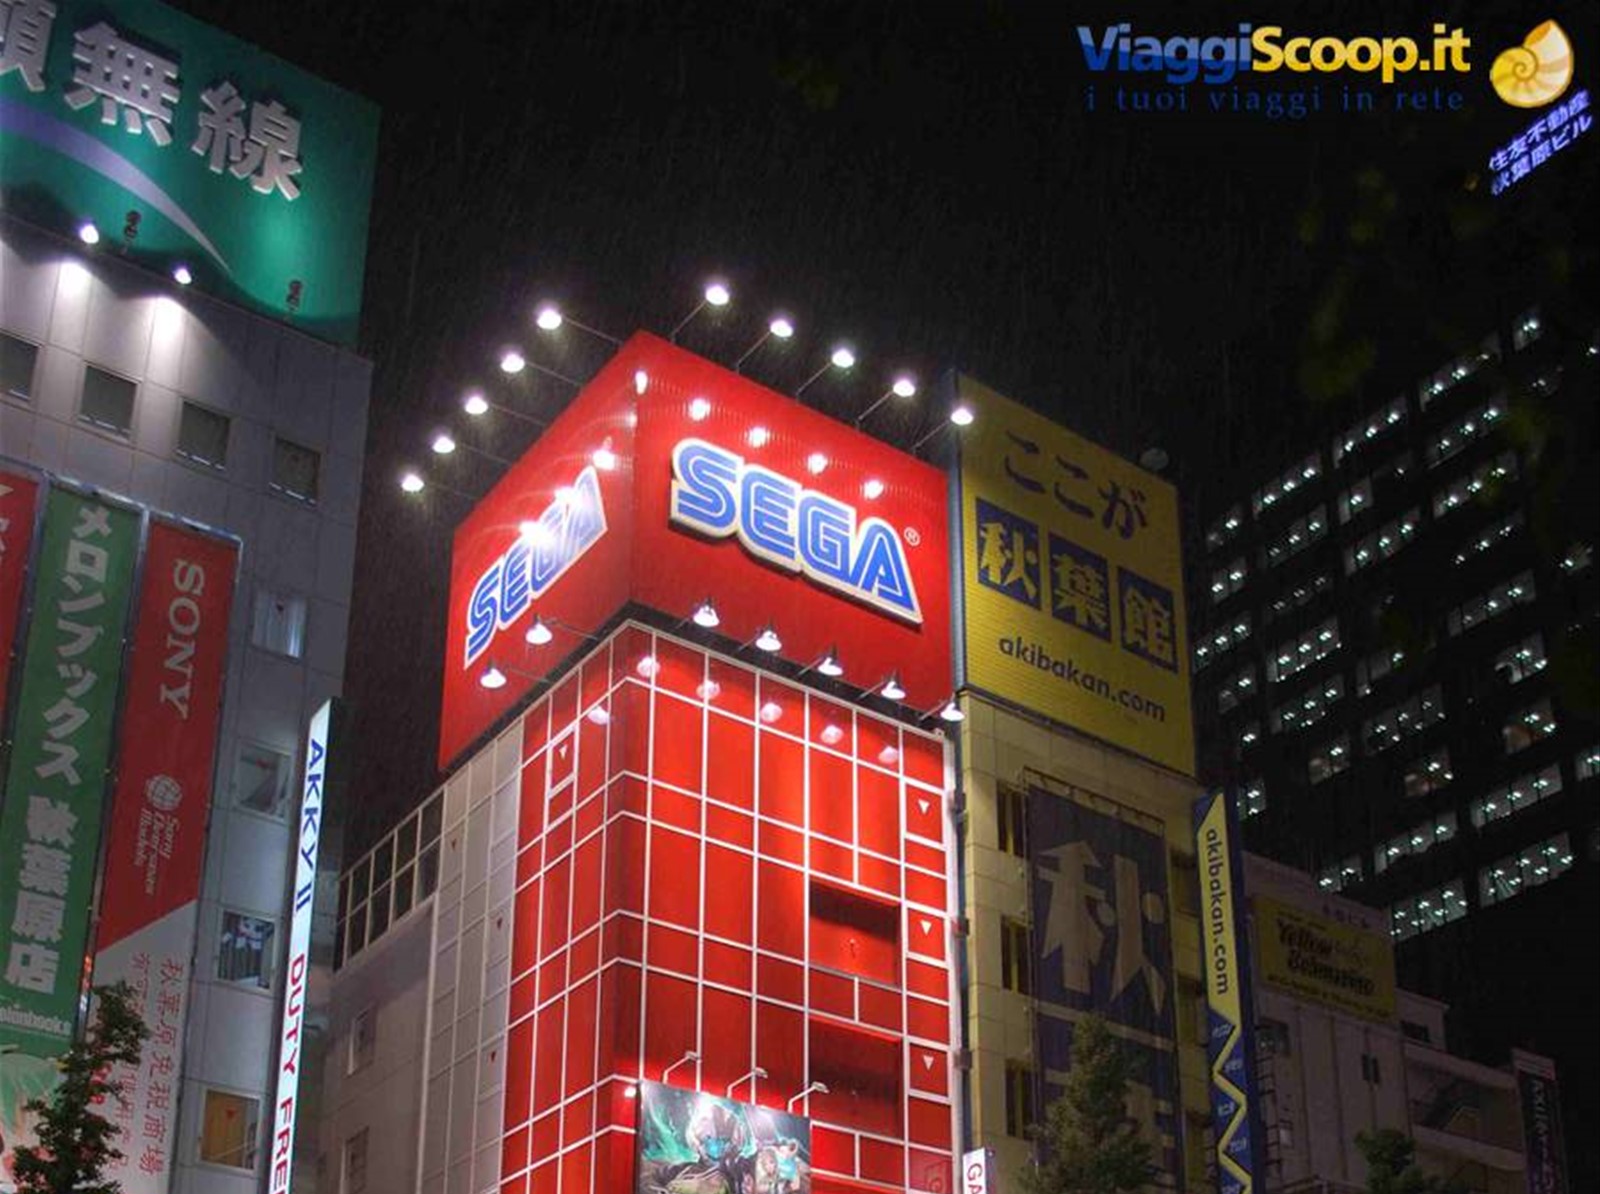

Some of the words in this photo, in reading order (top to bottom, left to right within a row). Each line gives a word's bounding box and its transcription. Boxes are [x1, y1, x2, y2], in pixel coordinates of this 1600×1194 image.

[670, 437, 923, 628] SEGA
[1004, 429, 1147, 541] ここが
[35, 505, 113, 787] メロンブックス
[160, 558, 207, 718] SONY
[465, 465, 607, 670] SEGA
[977, 505, 1177, 668] 秋葉館
[999, 635, 1165, 723] akibakan.com
[301, 738, 324, 869] AKKY
[1206, 828, 1229, 995] akibakan.com
[284, 954, 305, 1075] DUTY
